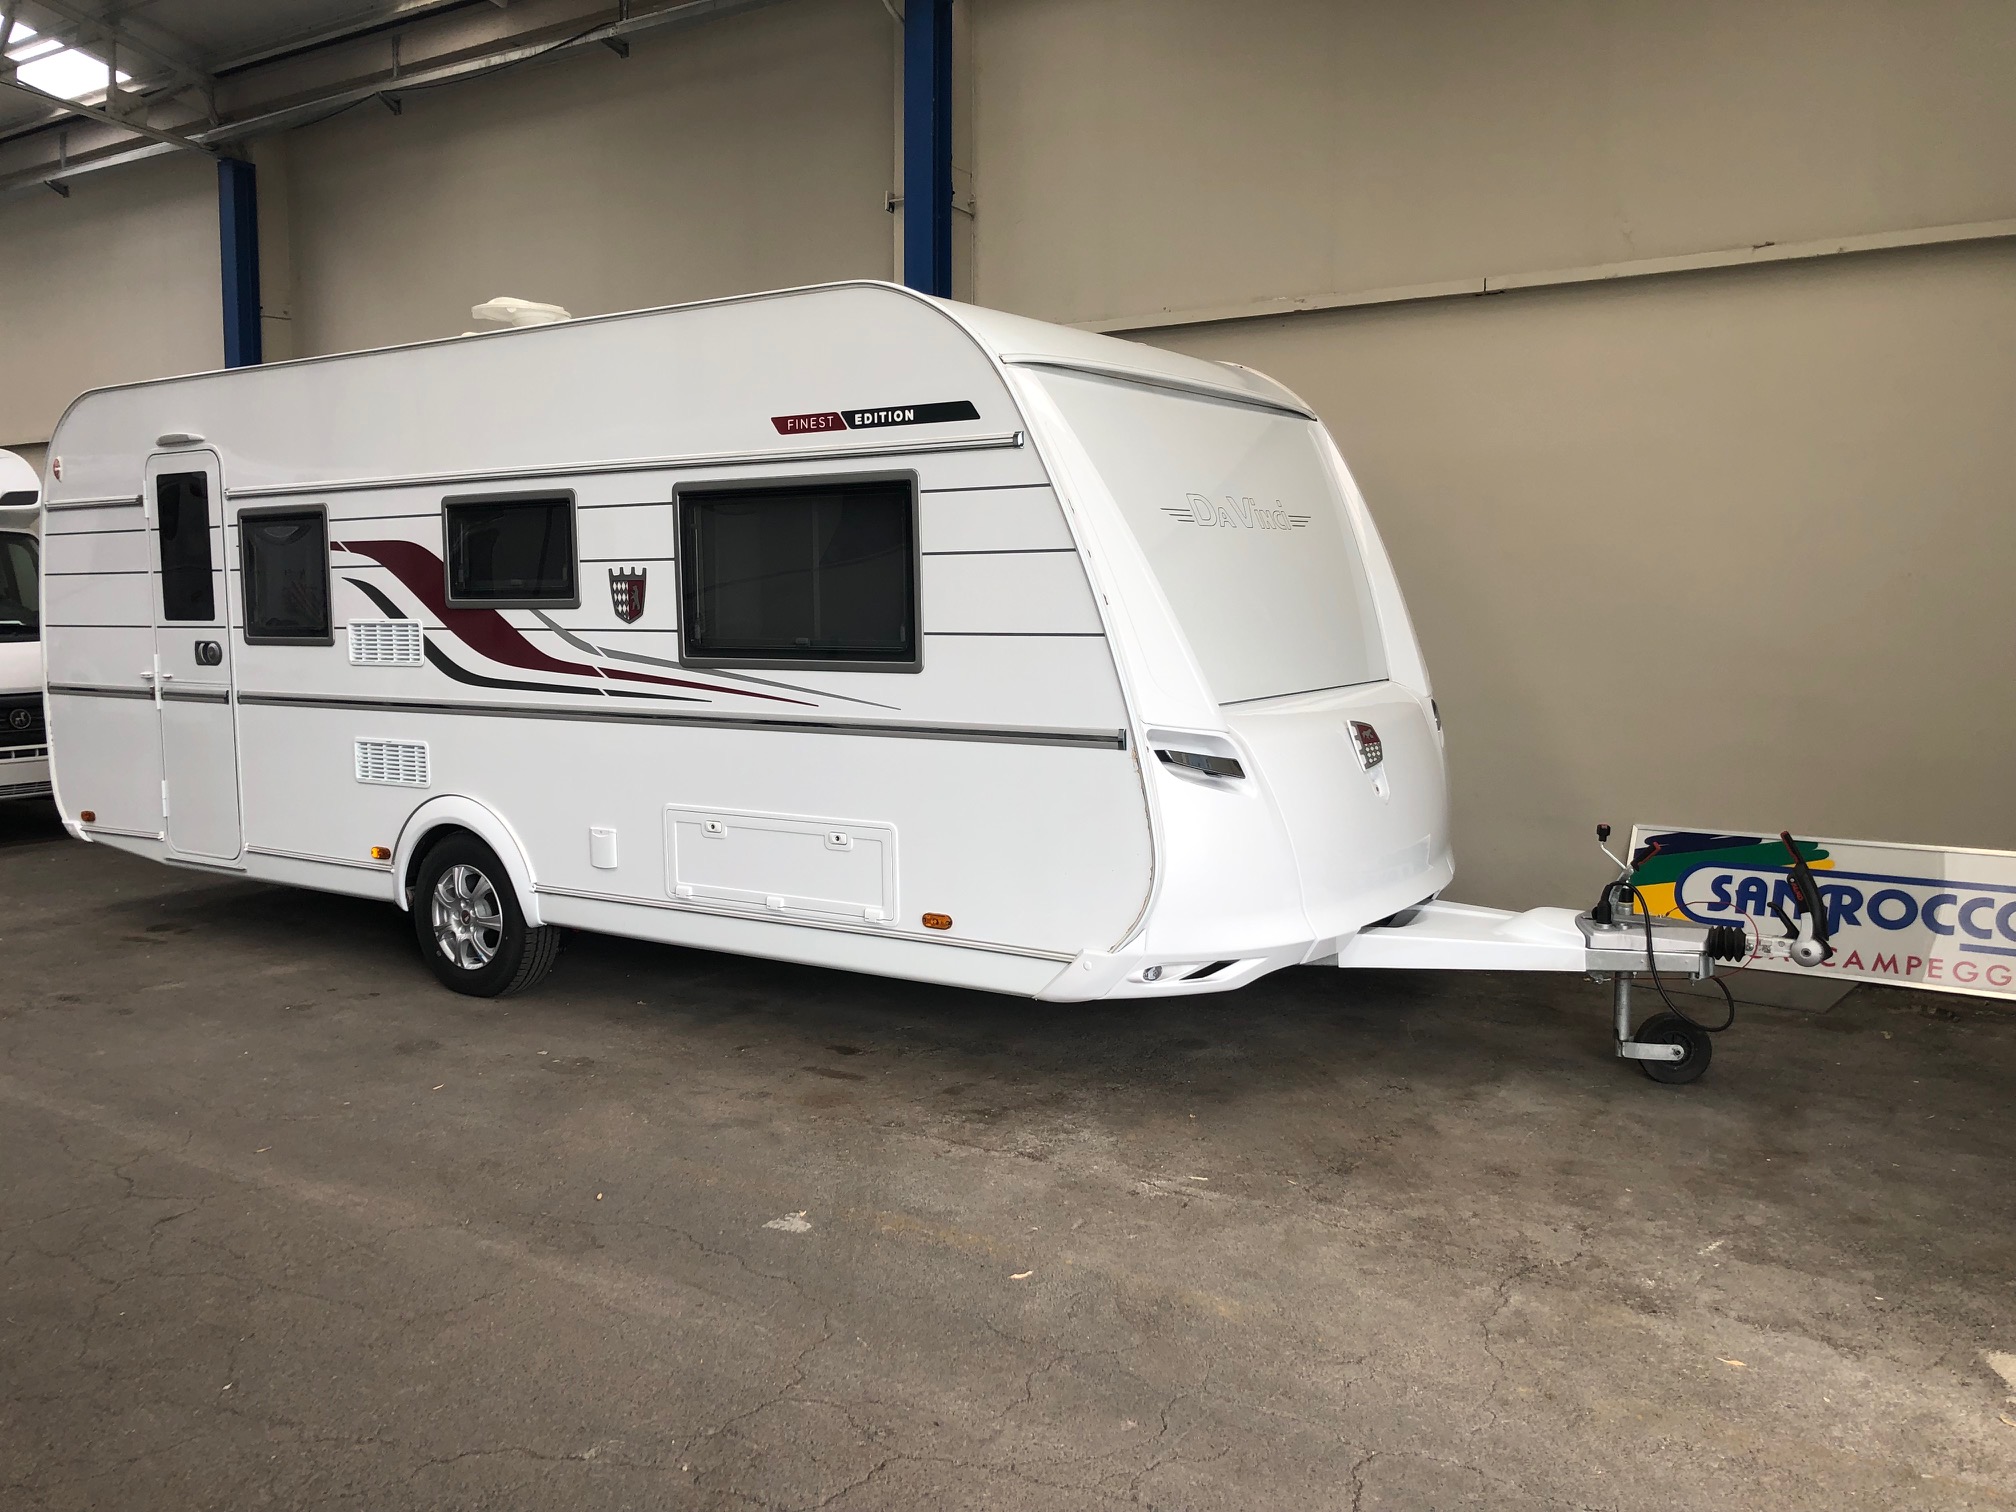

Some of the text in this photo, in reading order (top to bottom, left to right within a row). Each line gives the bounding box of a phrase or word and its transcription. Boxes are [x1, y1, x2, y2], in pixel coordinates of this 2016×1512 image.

[787, 409, 914, 431] FINEST EDITION
[1707, 874, 1802, 920] SAN
